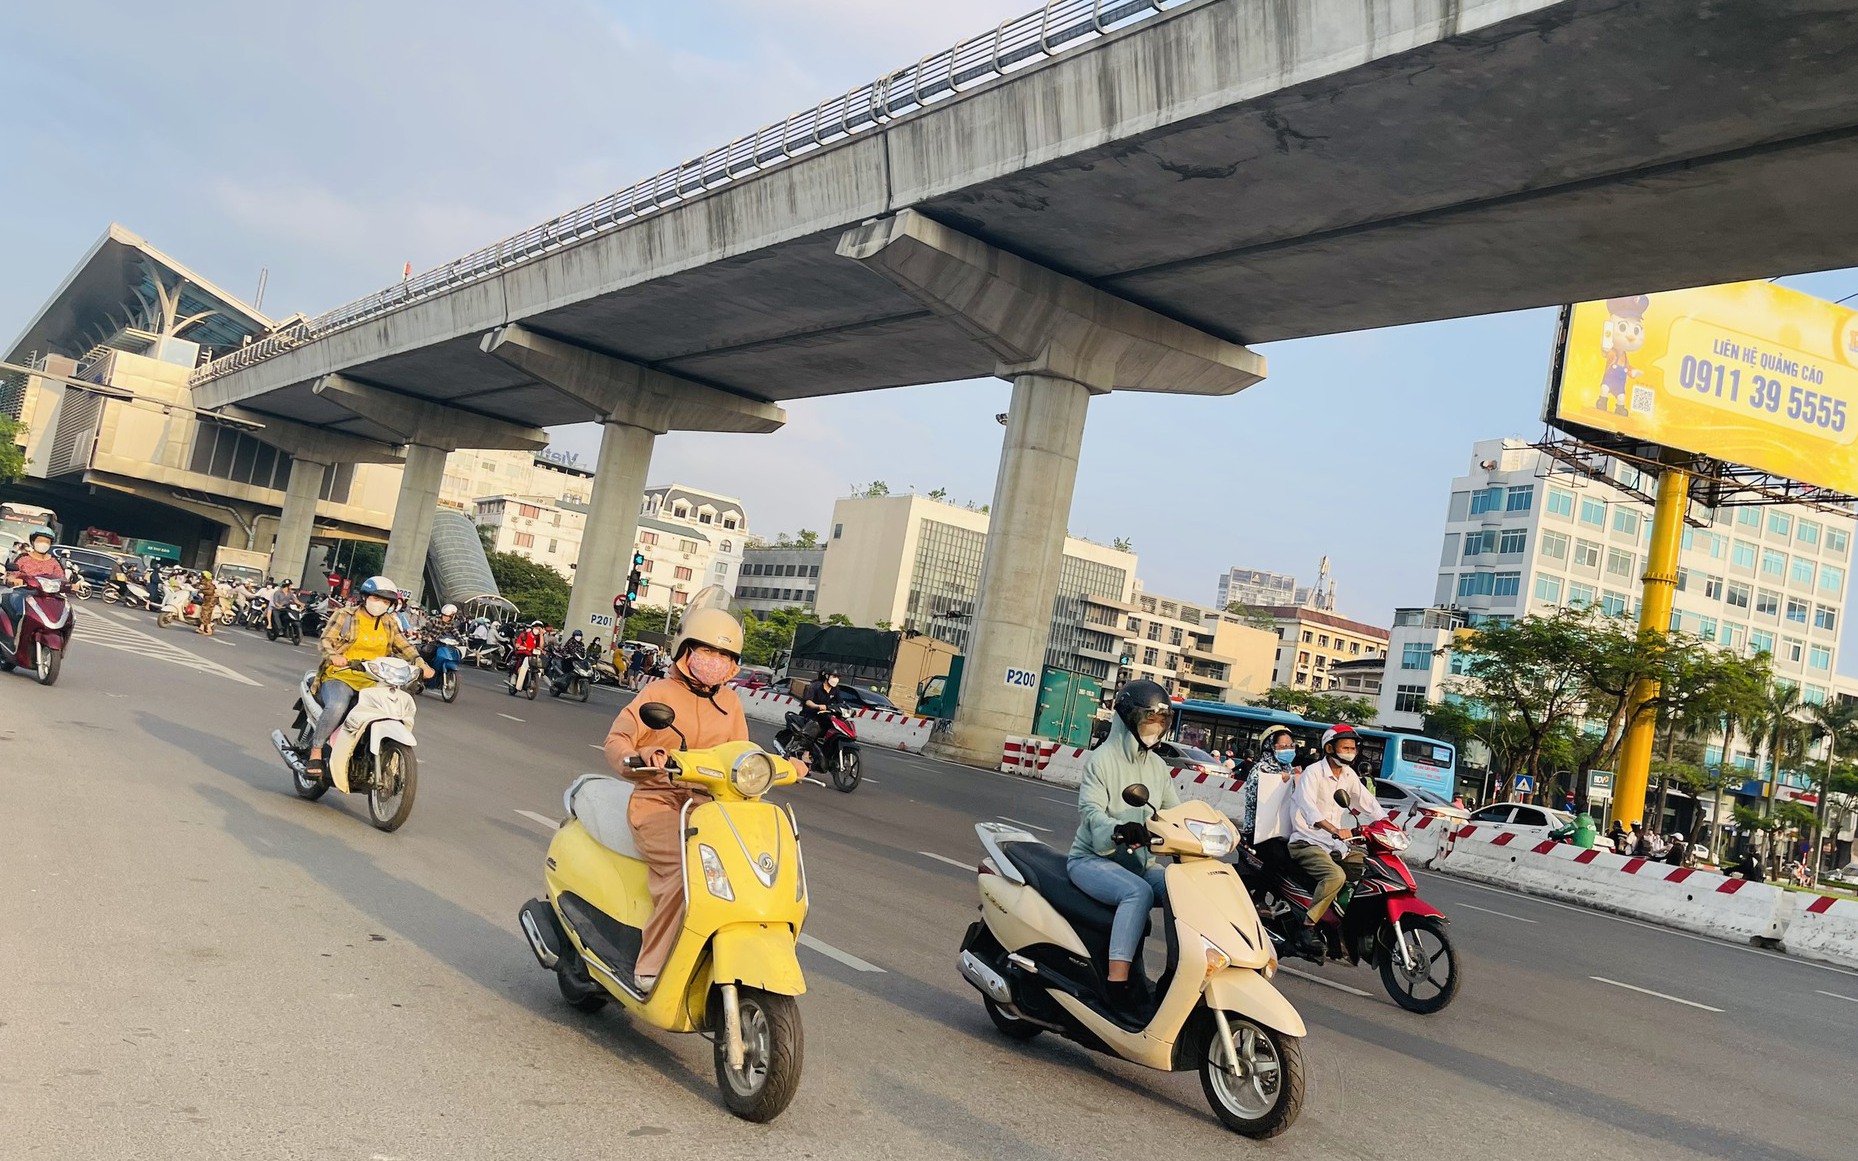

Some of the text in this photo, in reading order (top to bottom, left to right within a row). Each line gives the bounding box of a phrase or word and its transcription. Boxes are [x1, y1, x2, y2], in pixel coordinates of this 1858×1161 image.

[1713, 339, 1824, 385] LIÊN HỆ QUẢNG CÁO
[1679, 354, 1847, 433] 0911 39 5555
[591, 614, 613, 627] P201
[1006, 669, 1036, 688] P200
